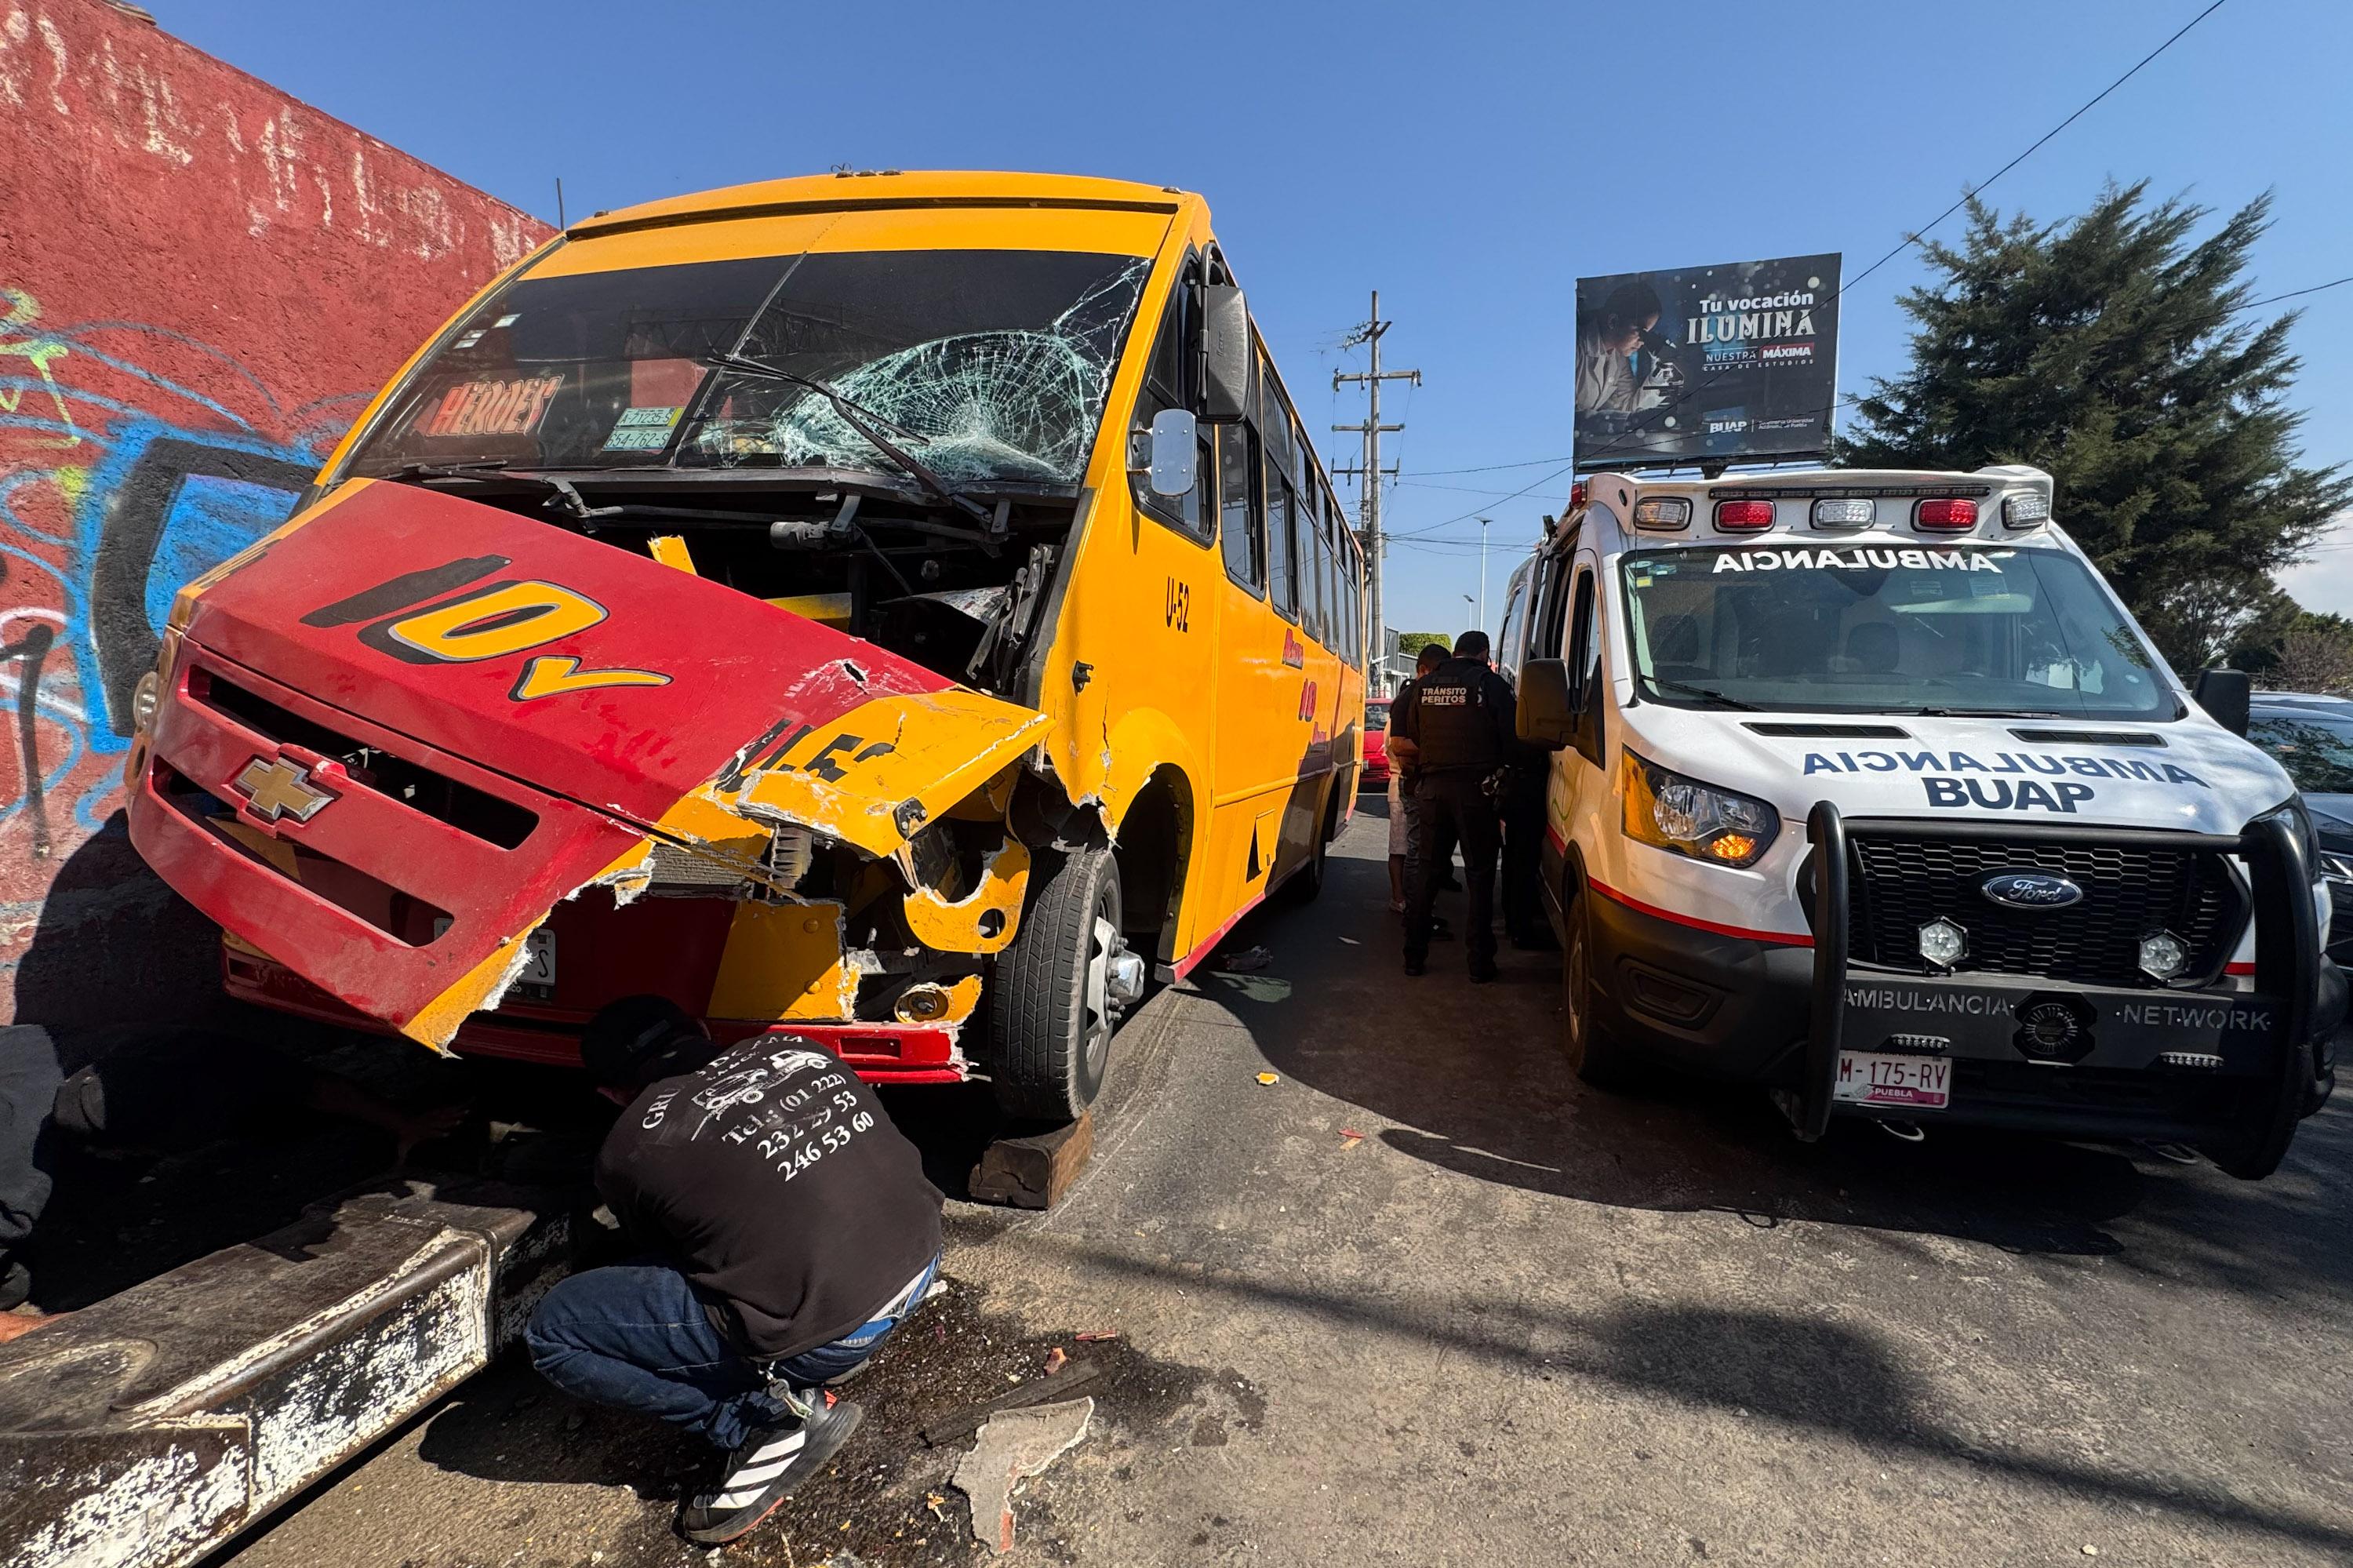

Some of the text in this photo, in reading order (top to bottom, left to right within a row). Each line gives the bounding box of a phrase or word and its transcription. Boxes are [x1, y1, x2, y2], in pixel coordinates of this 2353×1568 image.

[1700, 290, 1814, 313] Tu vocación
[1687, 309, 1816, 344] ILUMINA
[1706, 346, 1811, 362] NUESTRA MÁXIMA
[1758, 359, 1814, 368] ESTUDIOS
[1710, 421, 1747, 433] BUAP
[1166, 576, 1189, 633] U-52
[1421, 695, 1466, 704] PERITOS
[1422, 686, 1467, 696] TRÁNSITO
[1922, 777, 2095, 813] BUAP
[2008, 879, 2062, 900] Ford
[1844, 988, 2270, 1031] AMBULANCIA NETWORK
[1839, 1058, 1946, 1089] M-175-RV
[780, 1089, 812, 1111] (01
[811, 1073, 846, 1093] 222)
[832, 1090, 857, 1112] 53
[1875, 1087, 1913, 1097] PUEBLA
[777, 1111, 875, 1182] 246 53 60
